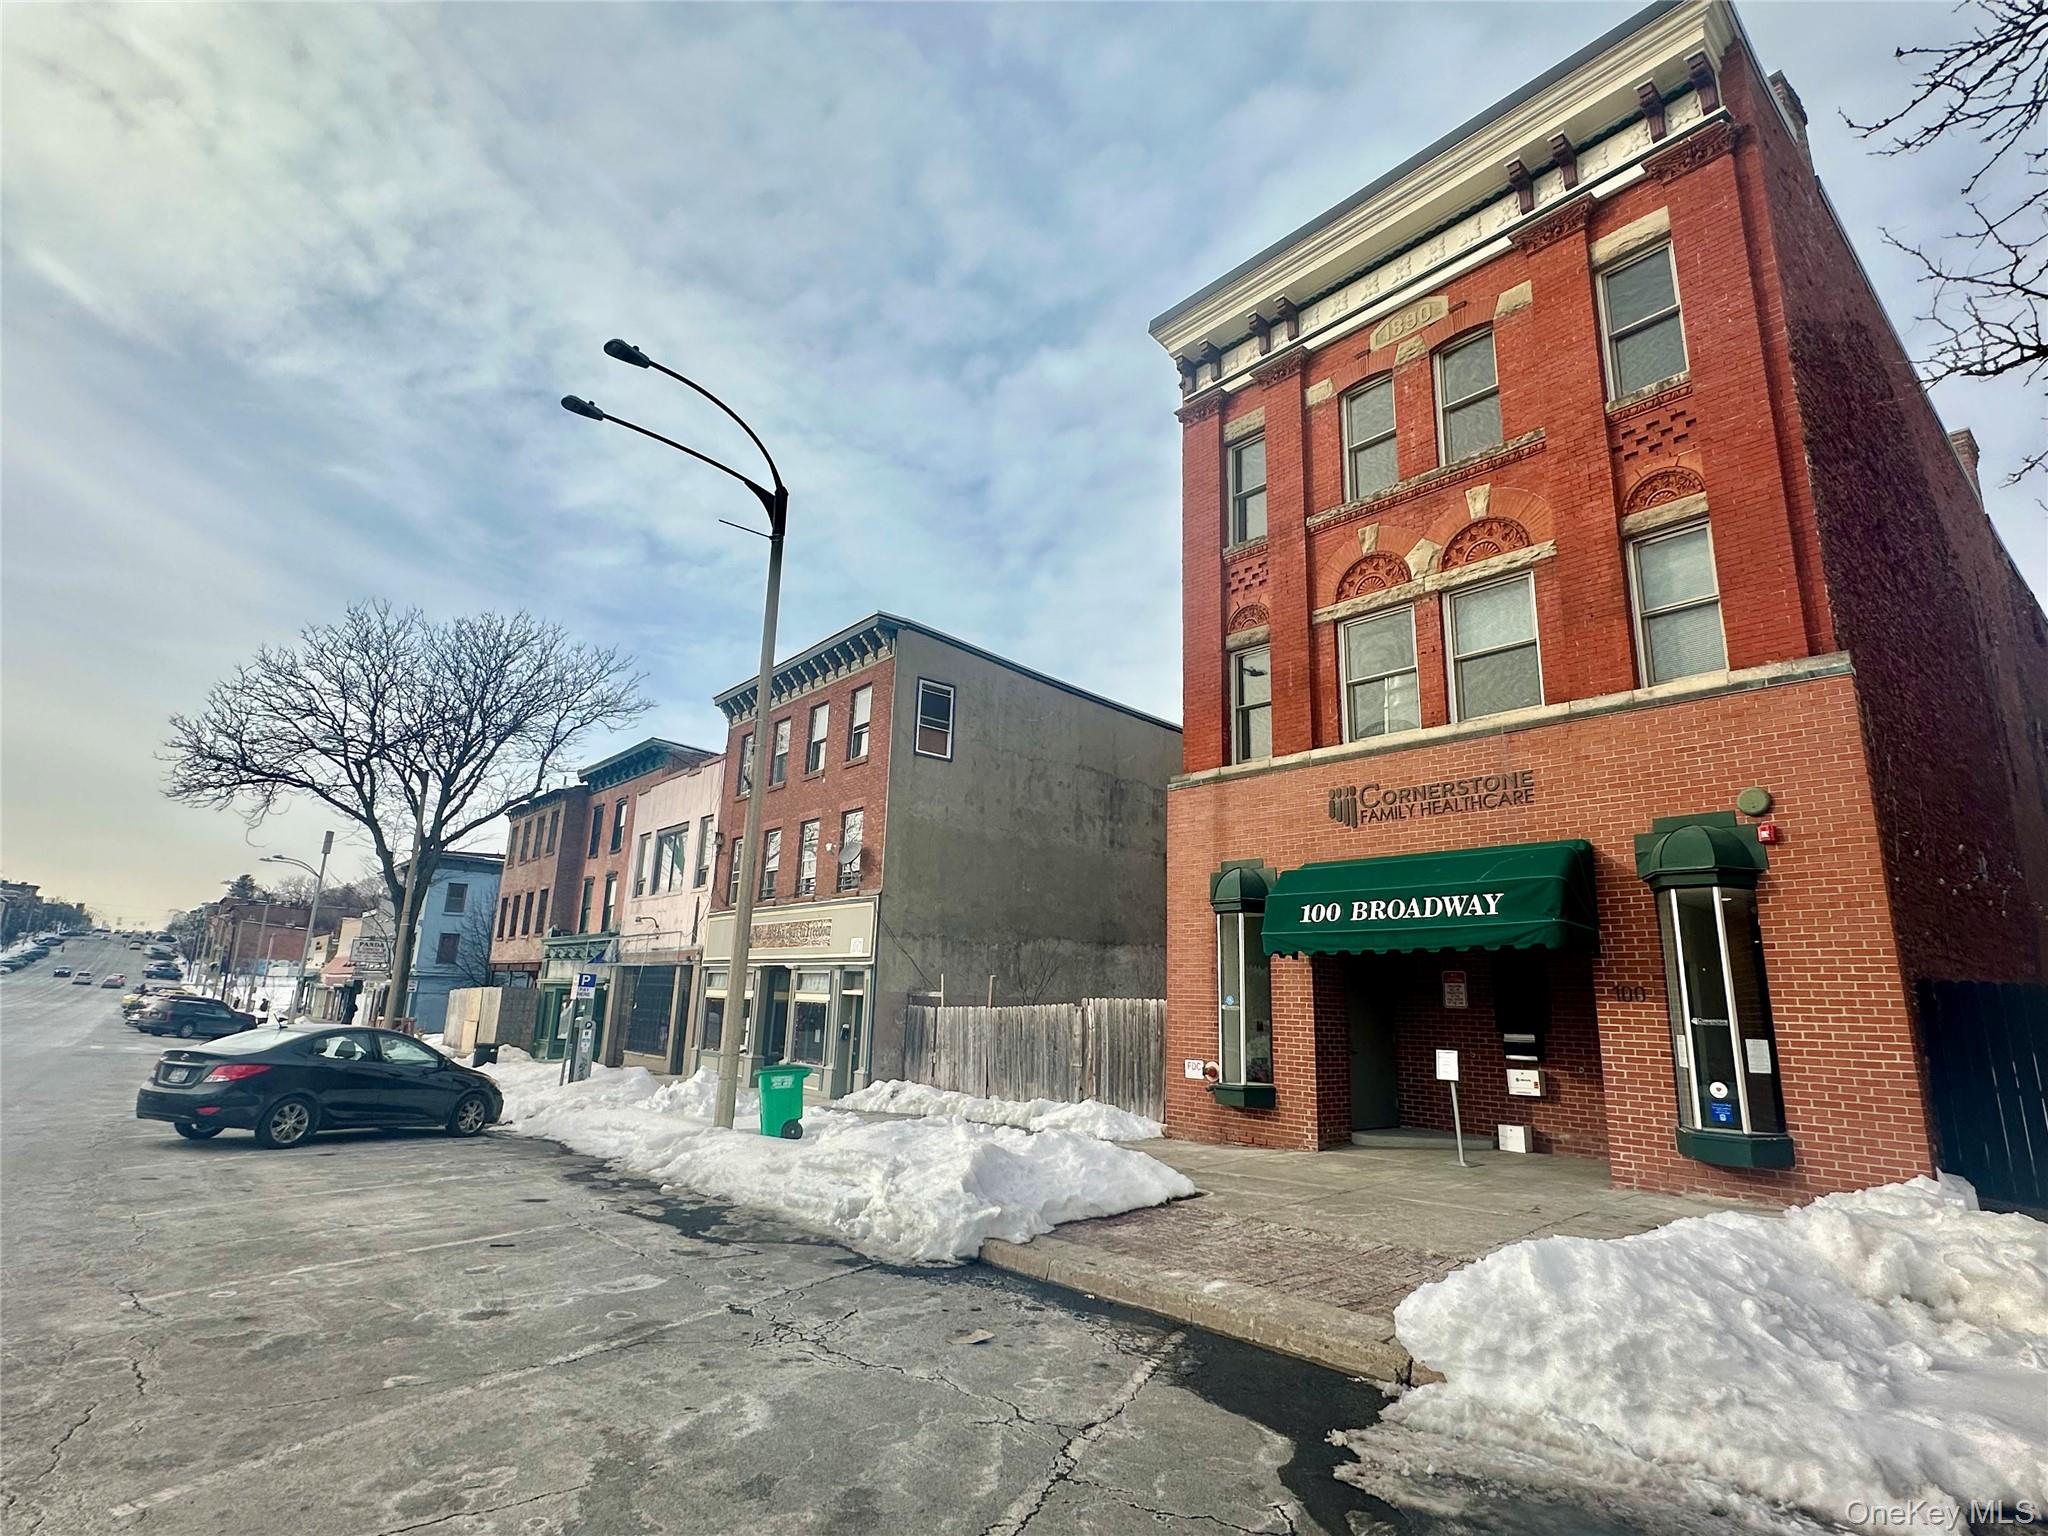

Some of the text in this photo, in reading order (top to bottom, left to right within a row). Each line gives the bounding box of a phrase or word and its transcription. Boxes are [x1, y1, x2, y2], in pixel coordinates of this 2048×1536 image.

[1384, 304, 1432, 341] 1890
[1359, 769, 1534, 809] CORNERSTONE
[1360, 787, 1535, 824] FAMILY HEALTHCARE
[1299, 892, 1505, 923] 100 BROADWAY
[581, 975, 591, 986] P
[1612, 984, 1646, 1002] 100
[1187, 1061, 1202, 1072] FDC
